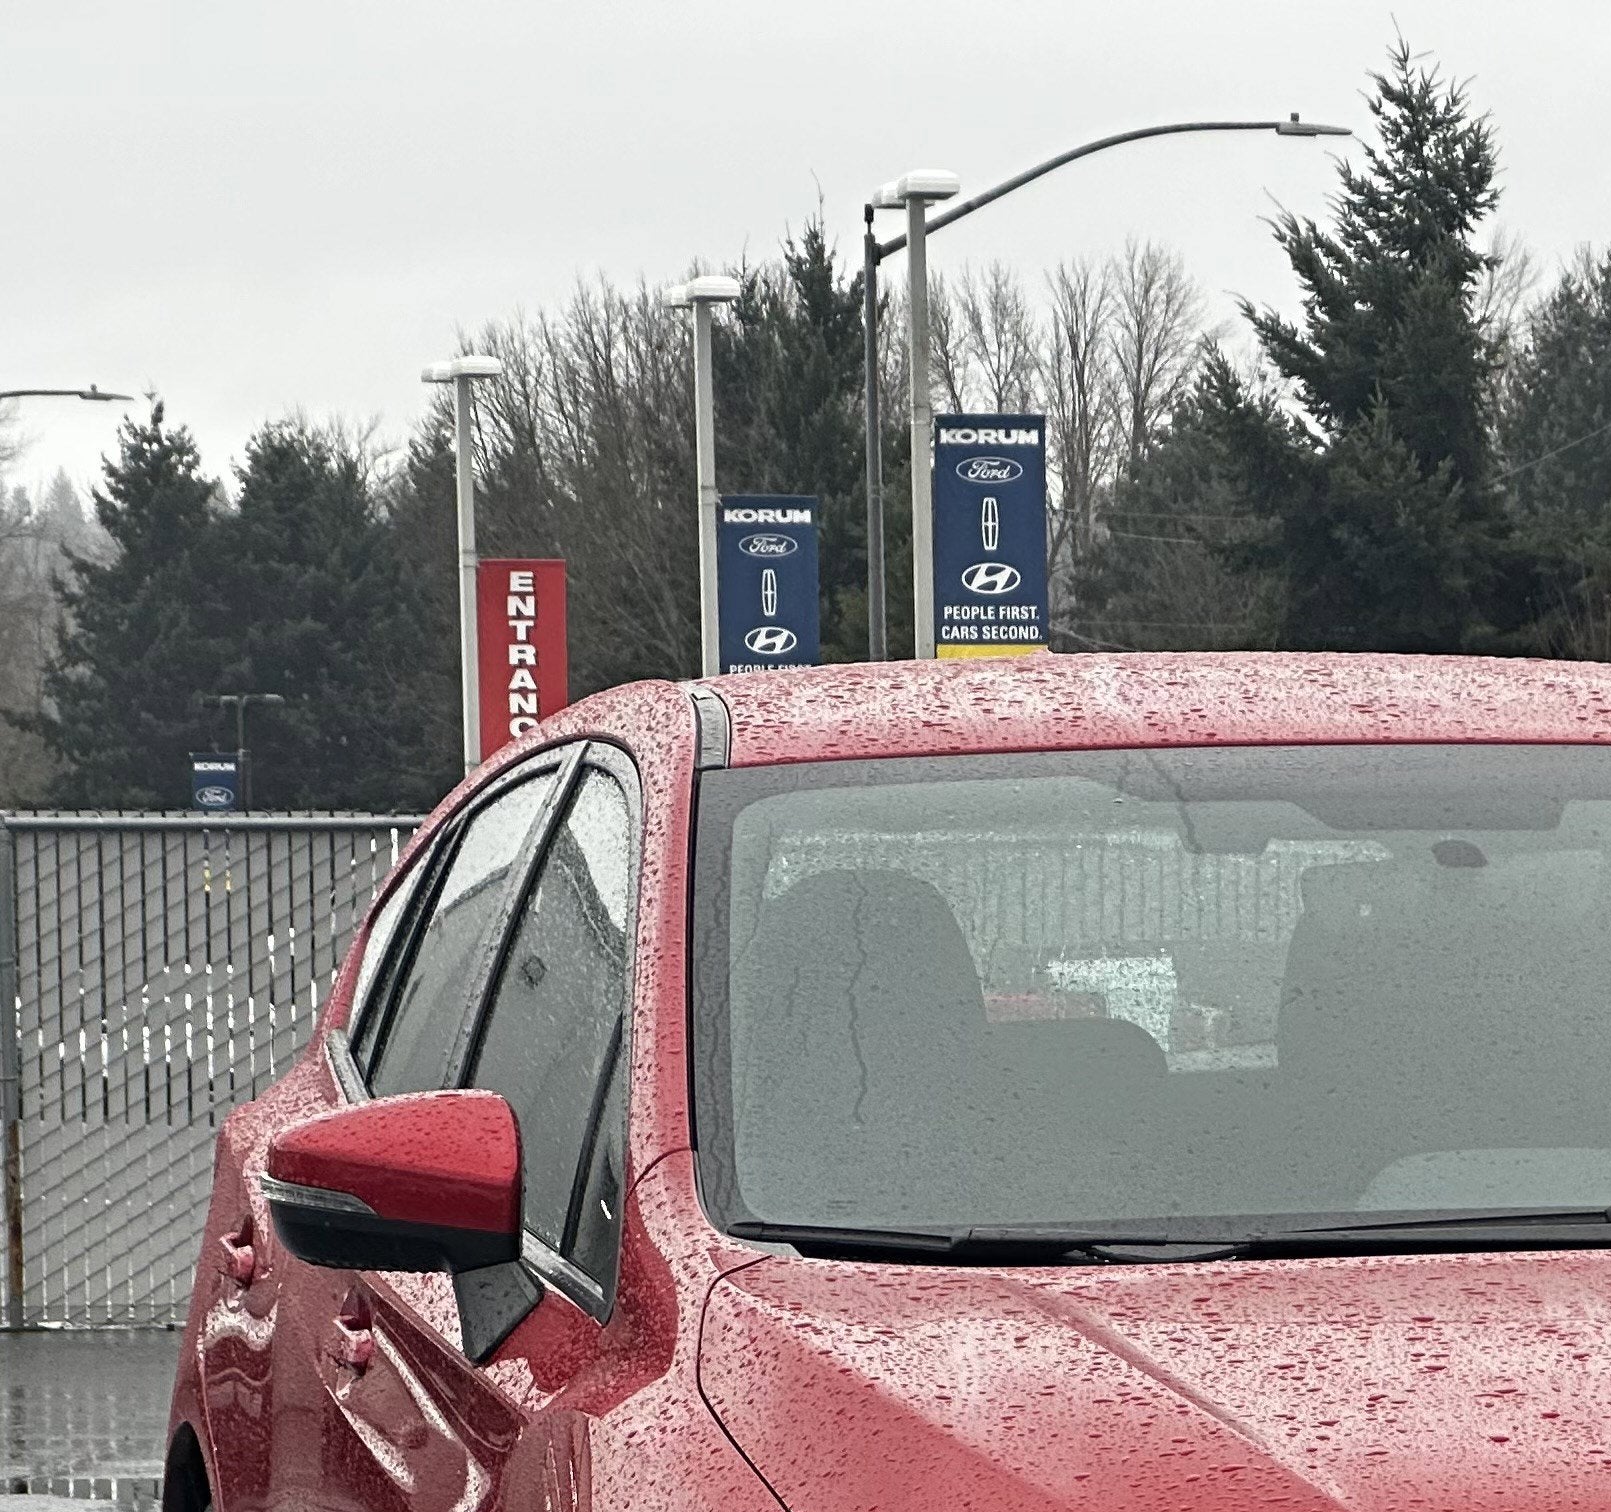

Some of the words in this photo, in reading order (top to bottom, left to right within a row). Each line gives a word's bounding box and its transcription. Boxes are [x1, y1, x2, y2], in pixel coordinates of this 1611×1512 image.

[940, 428, 1039, 445] KORUM
[967, 460, 1011, 479] Ford
[724, 508, 812, 523] KORUM
[944, 605, 996, 620] PEOPLE
[998, 605, 1040, 620] FIRST.
[941, 625, 979, 640] CARS
[981, 625, 1043, 640] SECOND.
[507, 571, 539, 738] ENTRANC
